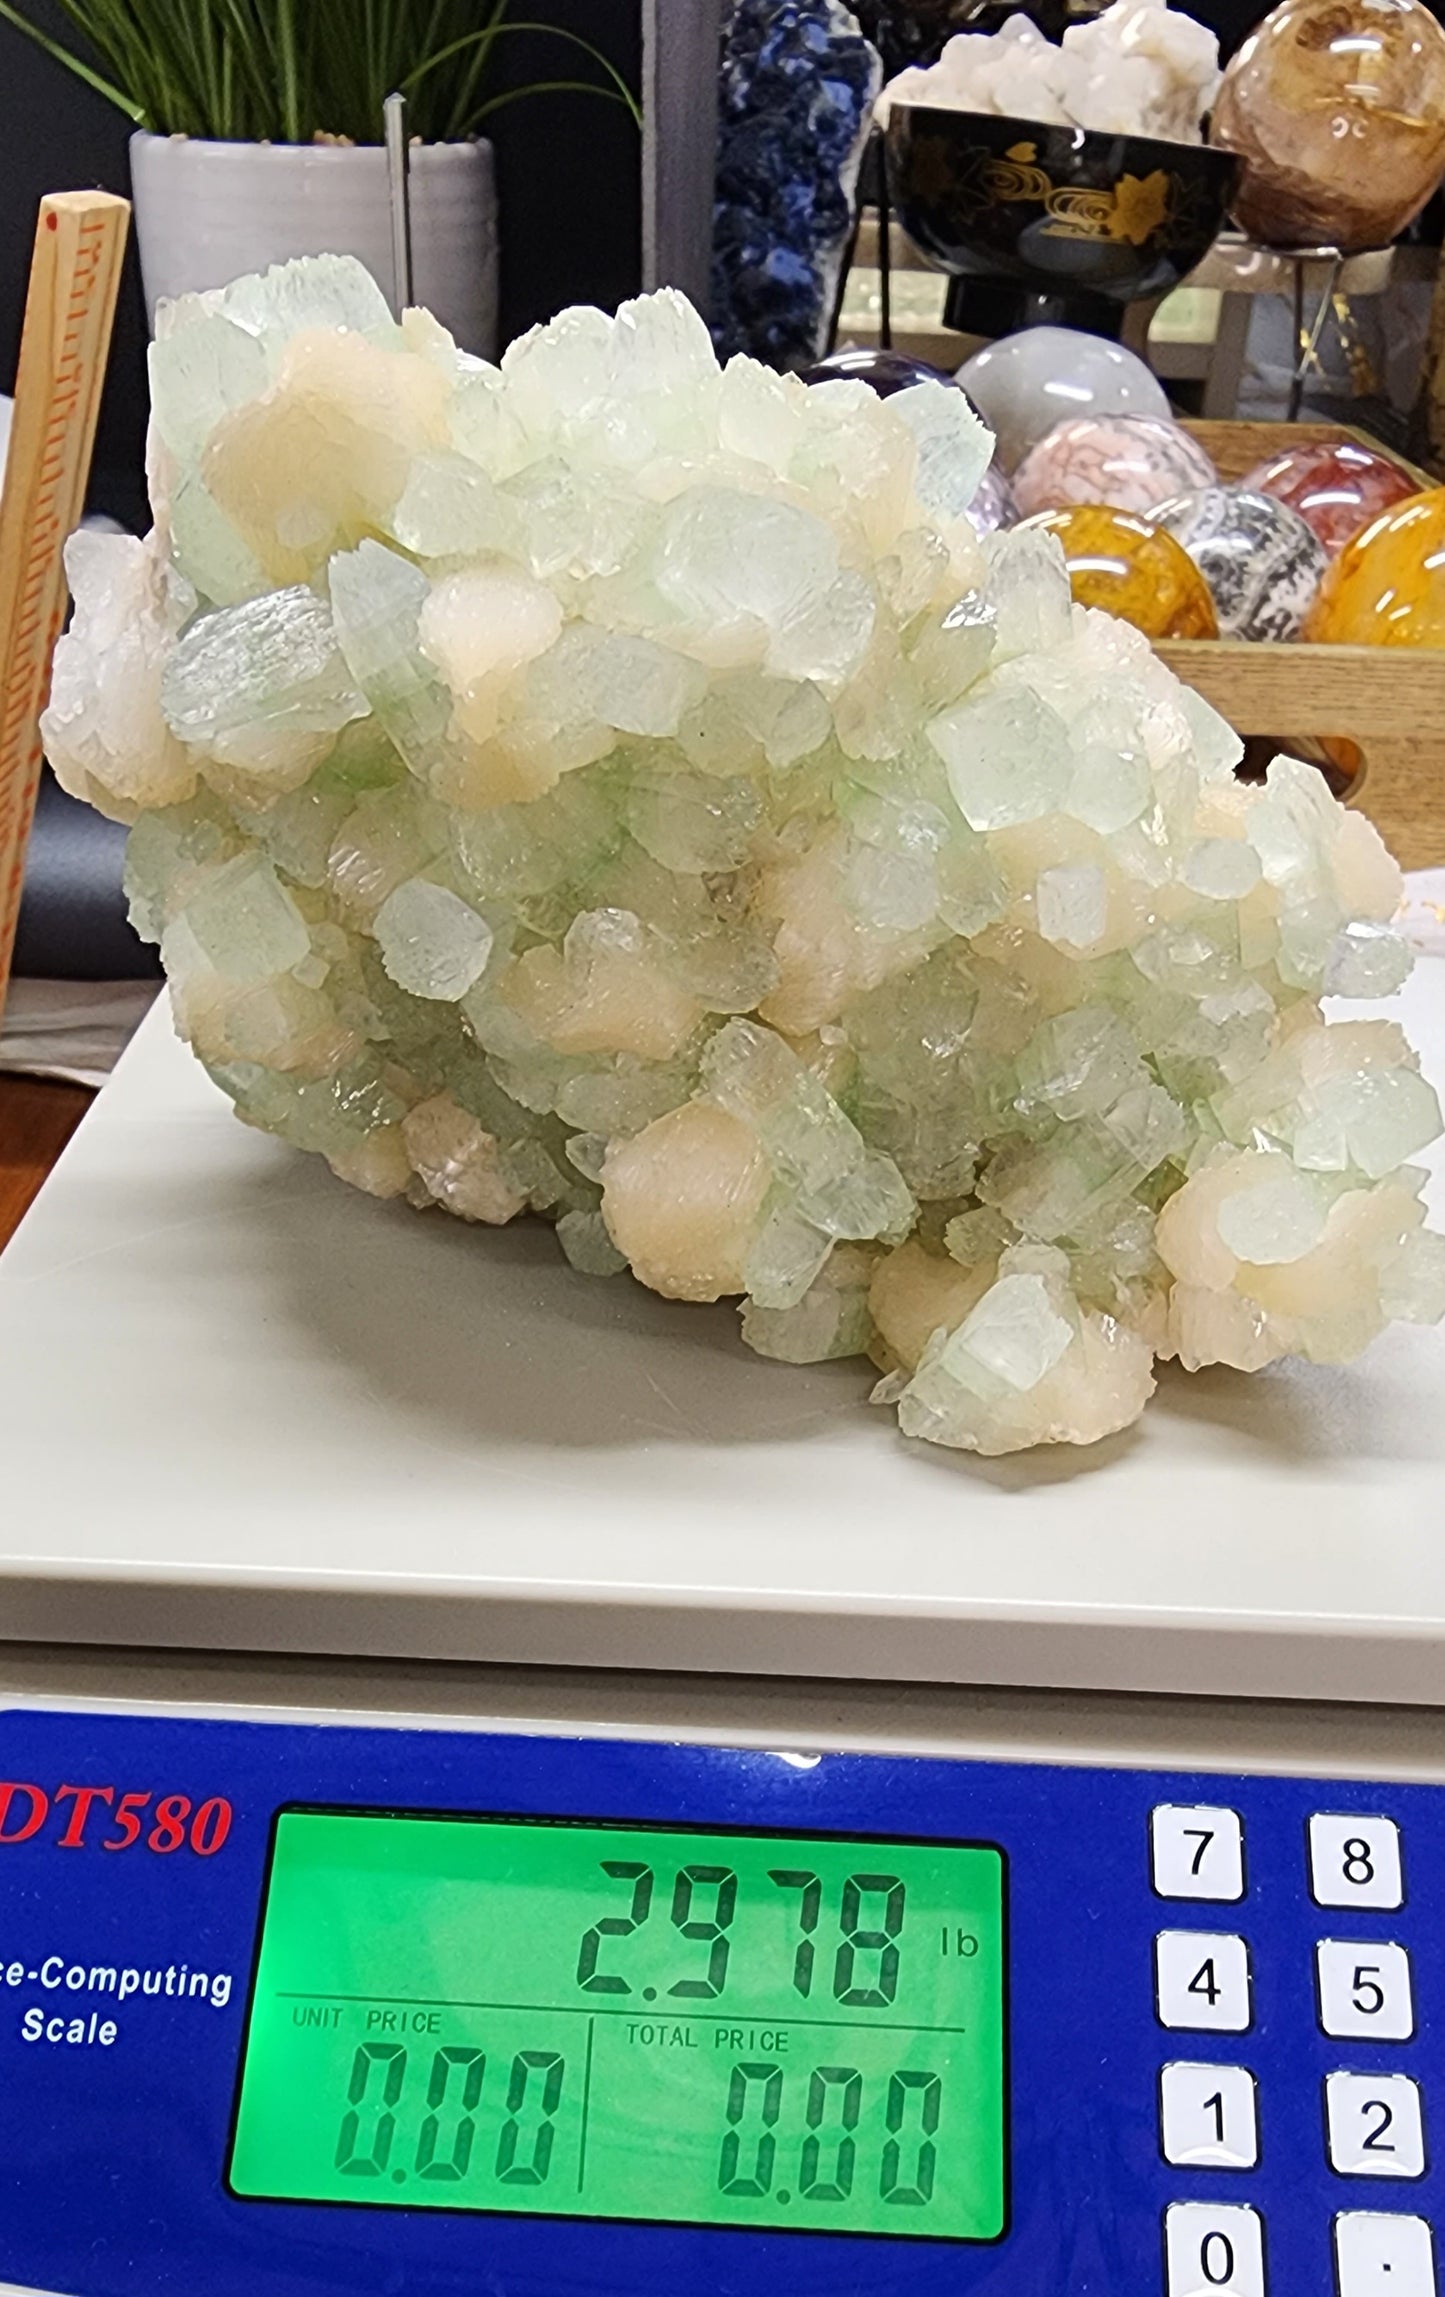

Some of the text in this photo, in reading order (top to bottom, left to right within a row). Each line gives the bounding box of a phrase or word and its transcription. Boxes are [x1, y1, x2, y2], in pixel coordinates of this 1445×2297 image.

[0, 1782, 232, 1855] DT580
[1183, 1829, 1215, 1876] 7
[1342, 1837, 1375, 1885] 8
[577, 1861, 980, 2008] 2.978 lb
[0, 1956, 232, 2007] e-Computing
[1187, 1958, 1222, 2006] 4
[1351, 1966, 1385, 2014] 5
[21, 2007, 118, 2046] Scale
[292, 2008, 442, 2034] UNIT PRICE
[626, 2023, 790, 2053] TOTAL PRICE
[334, 2042, 565, 2186] 0.00
[719, 2063, 942, 2207] 0.00
[1202, 2091, 1226, 2142] 1
[1360, 2100, 1396, 2152] 2
[1199, 2231, 1235, 2285] 0
